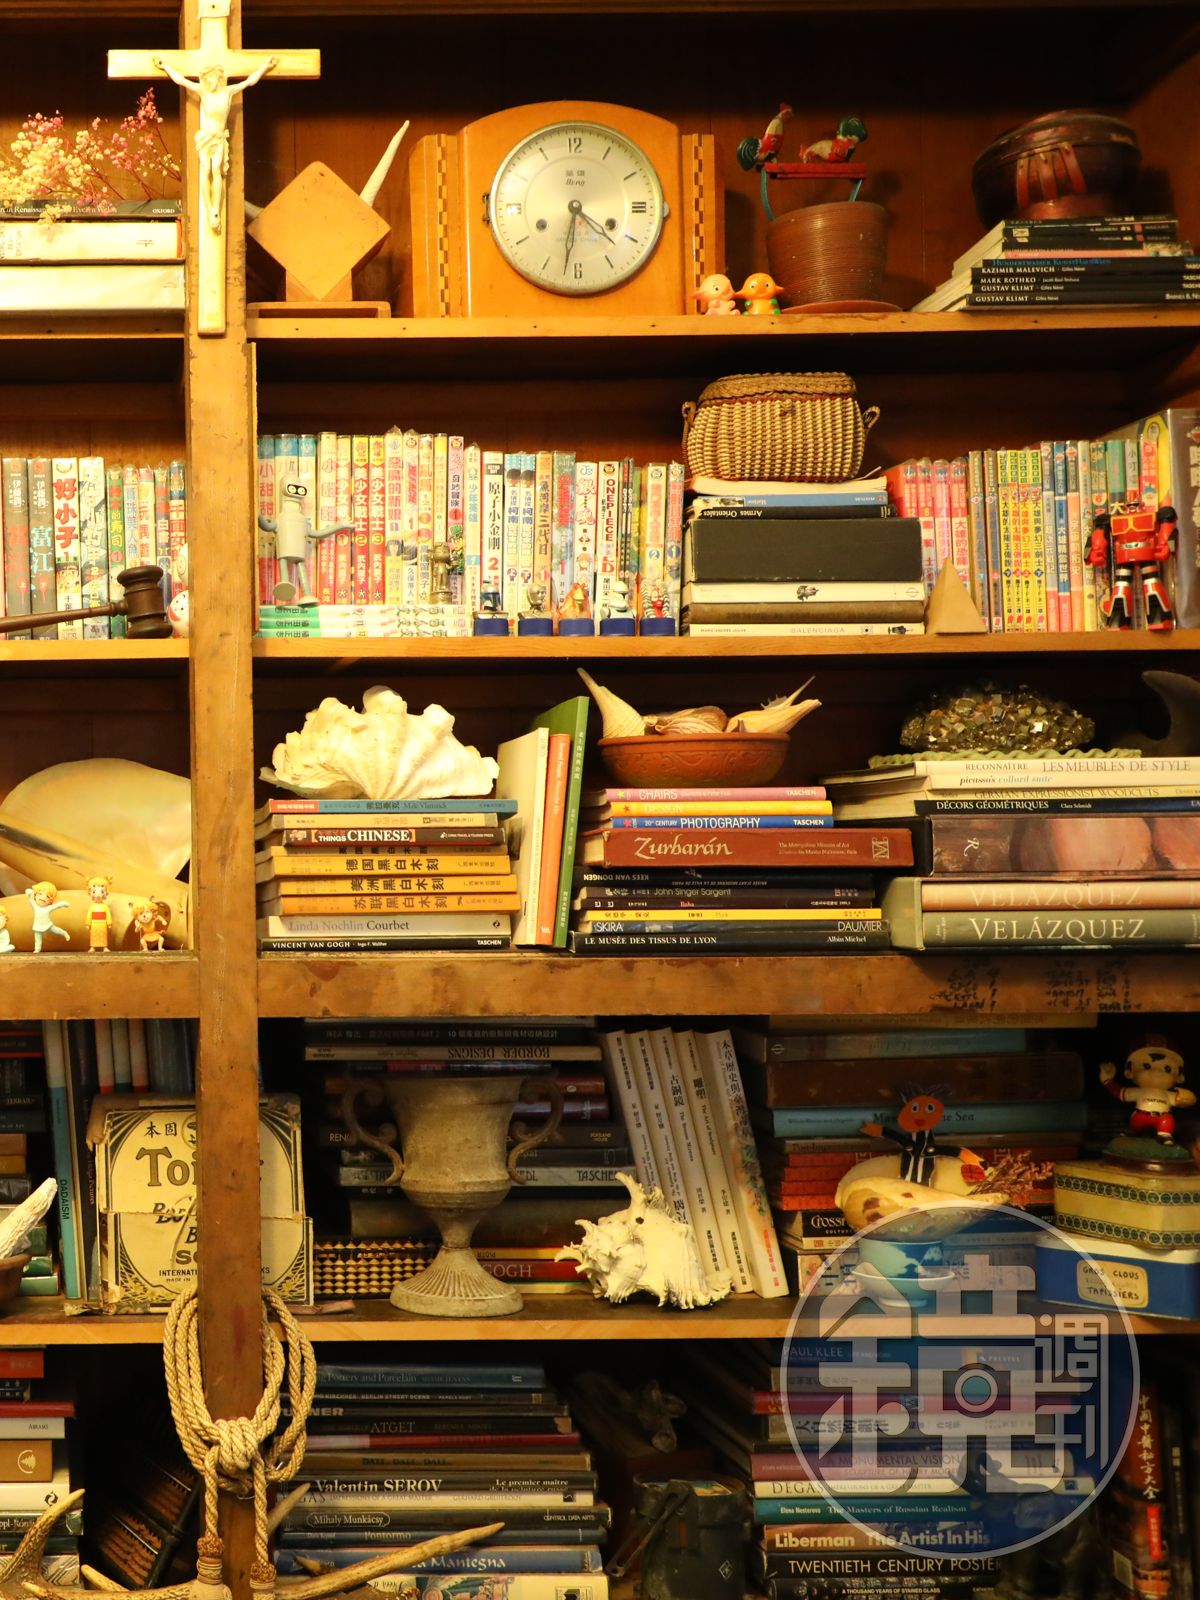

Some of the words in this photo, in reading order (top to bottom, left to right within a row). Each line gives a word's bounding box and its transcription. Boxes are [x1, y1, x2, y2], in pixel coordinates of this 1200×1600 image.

[568, 138, 582, 153] 12
[355, 464, 368, 532] 美少女戰士
[371, 464, 384, 532] 美少女戰士
[54, 478, 78, 548] 好小子
[488, 481, 500, 550] 原子小金剛
[703, 510, 738, 518] Orientales
[741, 510, 762, 518] Armes
[488, 557, 499, 571] 2
[1066, 761, 1126, 772] MEUBLES
[1130, 760, 1148, 772] DE
[1152, 760, 1191, 771] STYLE
[638, 789, 678, 800] CHAIRS
[936, 800, 974, 810] DÉCORS
[976, 800, 1049, 810] GÉOMÉTRIQUES
[680, 818, 760, 829] PHOTOGRAPHY
[347, 830, 410, 842] CHINESE
[634, 836, 732, 860] Zurbarán
[346, 859, 438, 871] 德国黑白木刻
[350, 878, 444, 891] 美洲黑白木刻
[654, 888, 673, 896] John
[675, 888, 700, 897] Singer
[701, 888, 732, 897] Sargent
[354, 896, 447, 909] 苏联黑白木刻
[322, 921, 363, 930] Nochlin
[366, 920, 410, 930] Courbet
[596, 922, 623, 932] SKIRA
[838, 921, 882, 931] DAUMIER
[970, 915, 1146, 942] VELÁZQUEZ
[598, 936, 628, 944] MUSÉE
[630, 936, 646, 944] DES
[648, 936, 676, 944] TISSUS
[679, 936, 692, 944] DE
[694, 936, 717, 944] LYON
[449, 1046, 495, 1058] DESIGNS
[503, 1046, 550, 1058] BORDER
[955, 1112, 974, 1121] Sea
[60, 1179, 70, 1220] DADAISM
[1082, 1266, 1105, 1277] GROS
[816, 1347, 843, 1358] KLEE
[370, 1422, 416, 1433] ATGET
[316, 1479, 378, 1492] Valentin
[384, 1478, 442, 1492] SEROV
[772, 1482, 824, 1494] DEGAS
[827, 1506, 843, 1514] The
[848, 1506, 880, 1514] Masters
[884, 1506, 893, 1514] of
[896, 1506, 930, 1514] Russian
[775, 1533, 855, 1548] Liberman
[867, 1533, 897, 1546] The
[900, 1530, 944, 1545] Artist
[947, 1530, 962, 1545] In
[431, 1557, 506, 1571] Mantegna
[789, 1560, 870, 1574] TWENTIETH
[877, 1559, 944, 1572] CENTURY
